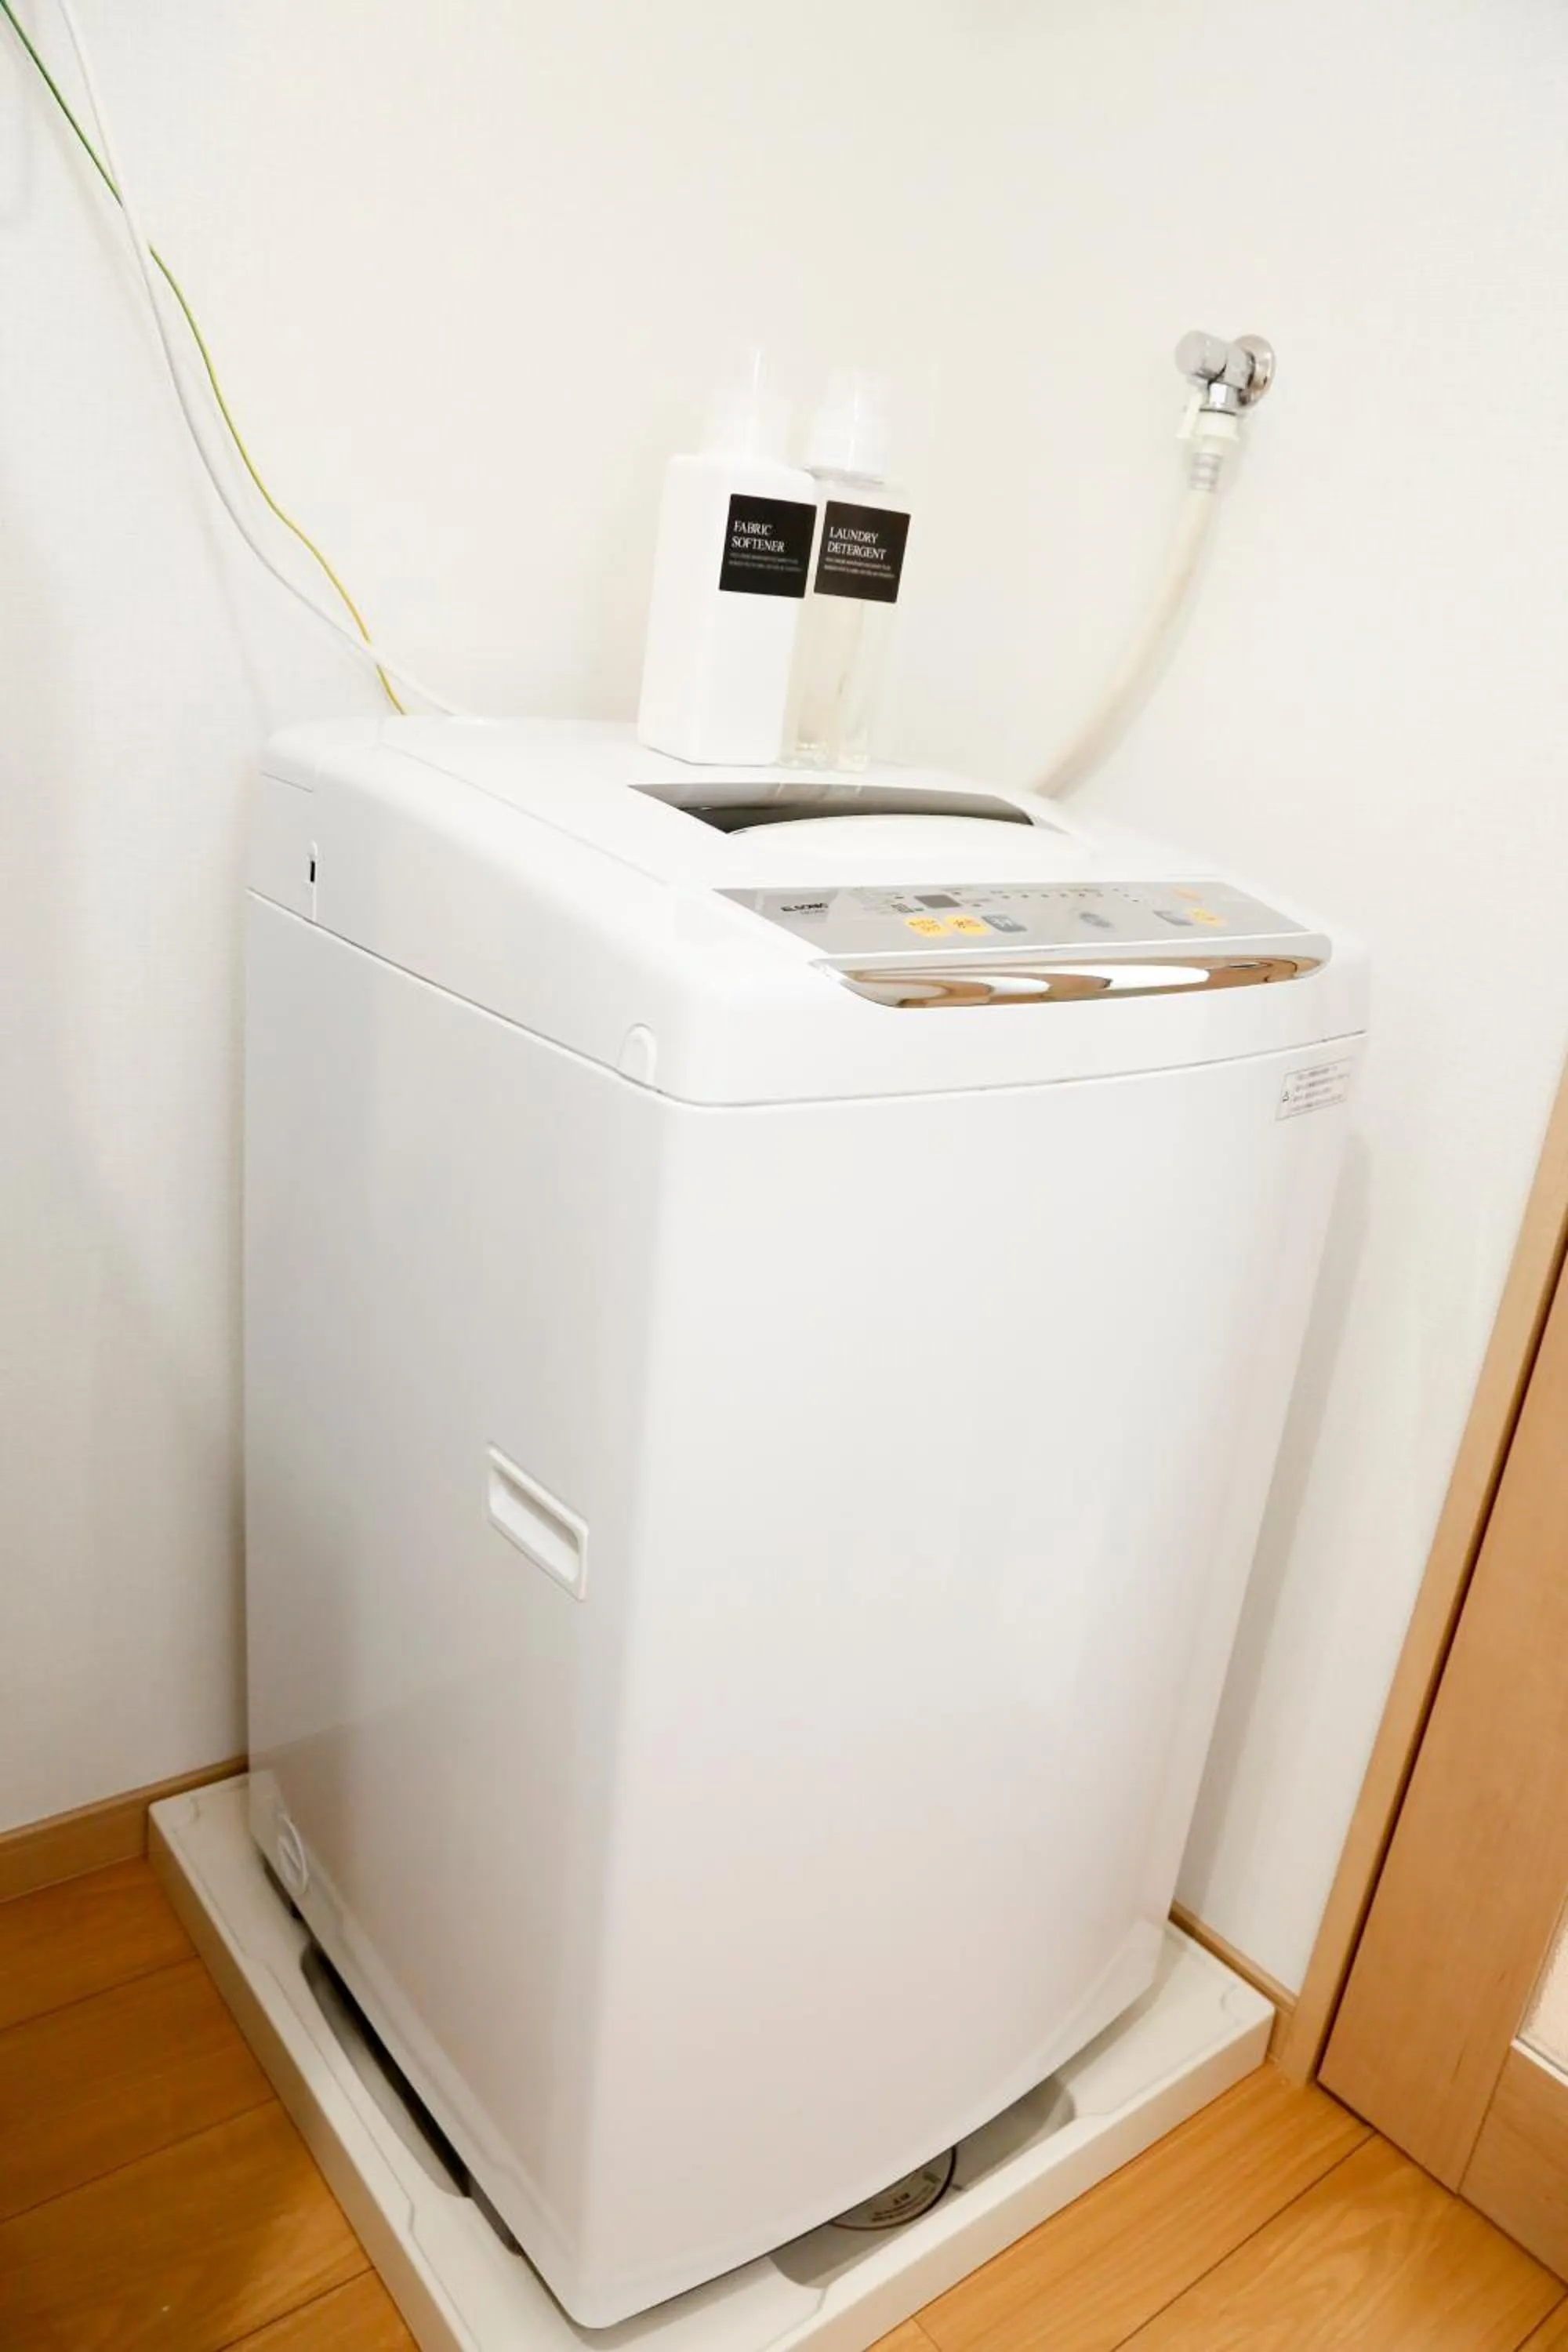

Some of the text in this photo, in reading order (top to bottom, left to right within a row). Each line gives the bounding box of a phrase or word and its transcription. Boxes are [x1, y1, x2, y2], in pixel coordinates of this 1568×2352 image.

[734, 521, 773, 535] FABRIC
[829, 527, 879, 544] LAUNDRY
[731, 535, 785, 552] SOFTENER
[827, 541, 887, 560] DETERGENT
